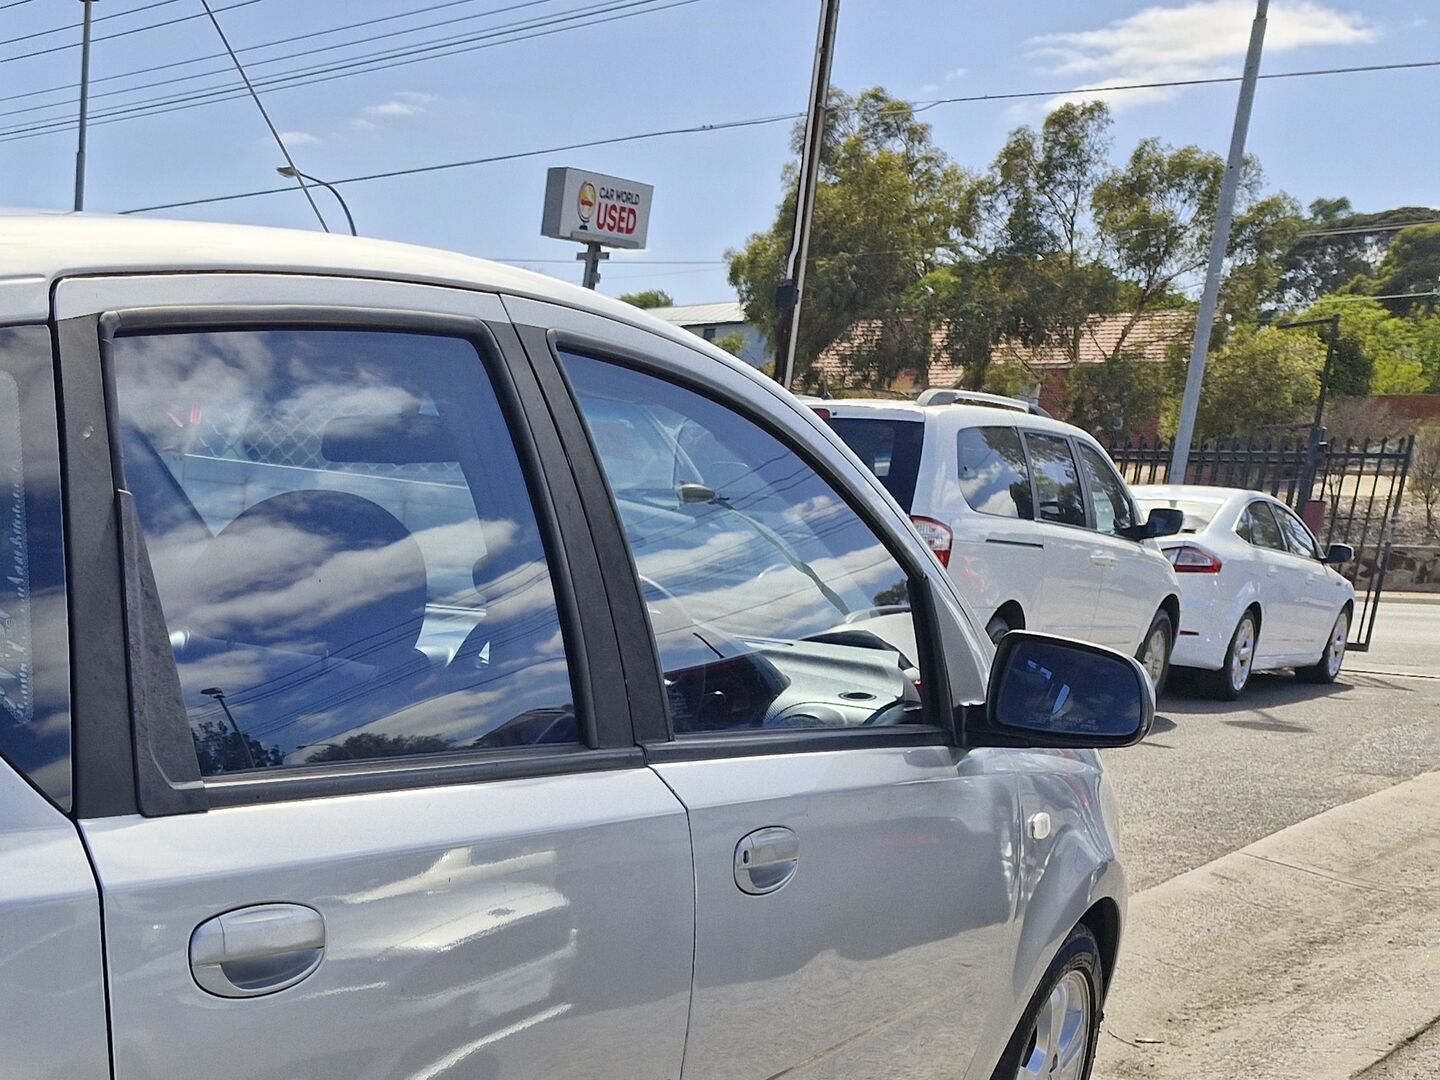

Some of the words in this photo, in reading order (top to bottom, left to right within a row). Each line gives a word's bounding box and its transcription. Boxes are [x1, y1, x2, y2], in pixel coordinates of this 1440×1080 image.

[599, 187, 614, 200] CAR
[615, 190, 640, 205] WORLD
[596, 202, 637, 235] USED
